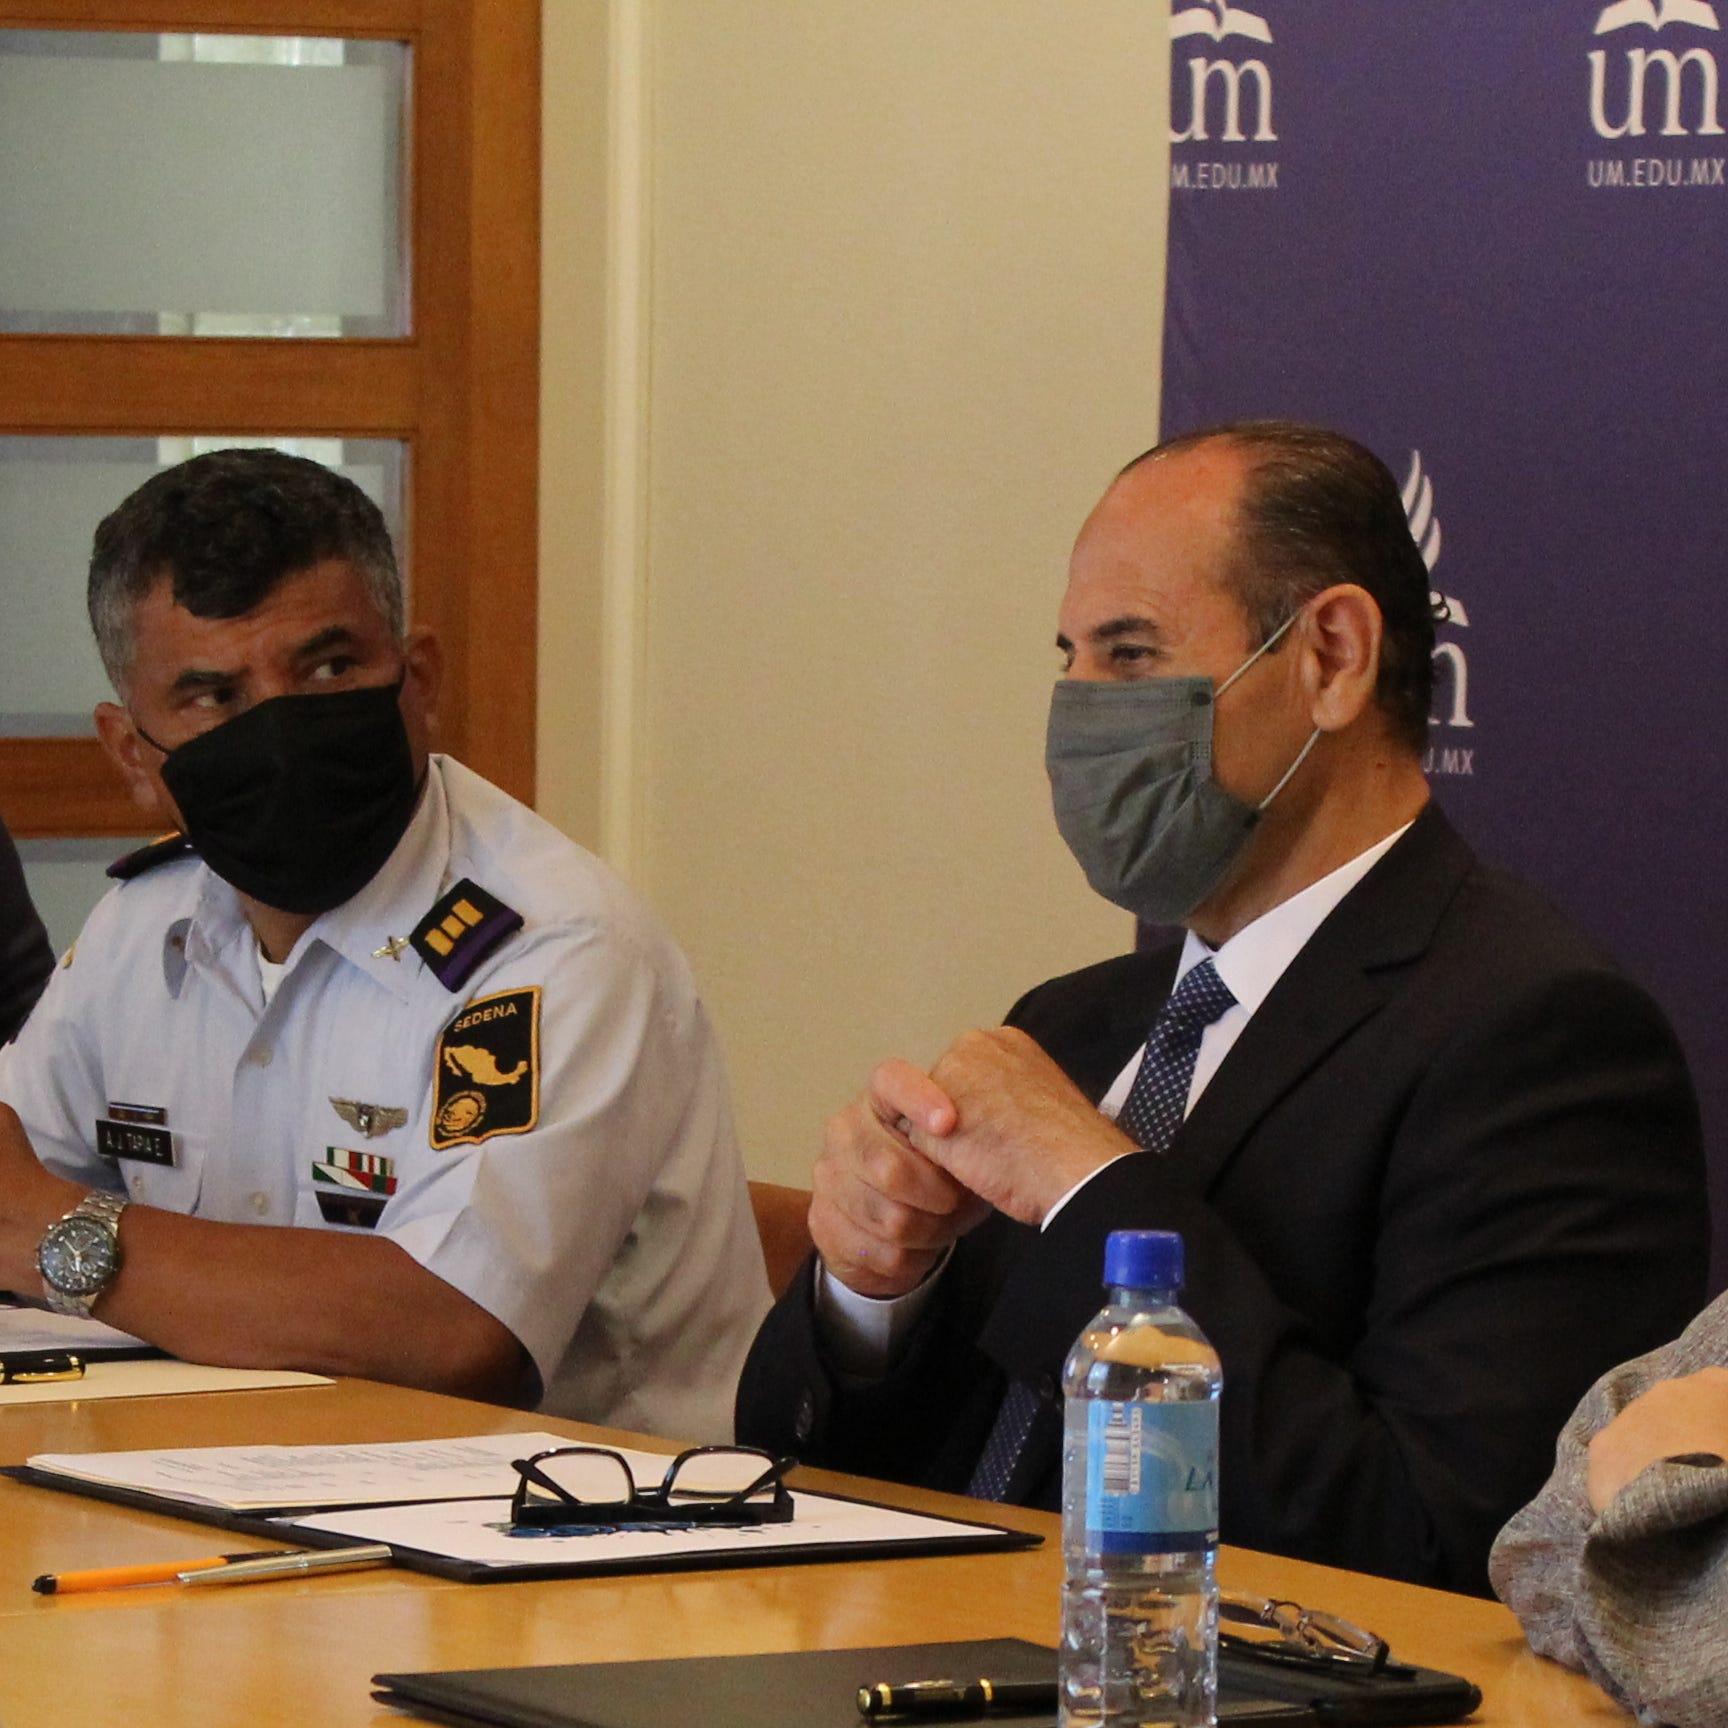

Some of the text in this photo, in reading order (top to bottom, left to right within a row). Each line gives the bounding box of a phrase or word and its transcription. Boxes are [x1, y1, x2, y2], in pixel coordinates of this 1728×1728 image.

[1587, 47, 1726, 140] um
[1172, 163, 1280, 188] M.EDU.MX
[1588, 158, 1726, 187] UM.EDU.MX
[453, 1002, 518, 1032] SEDENA
